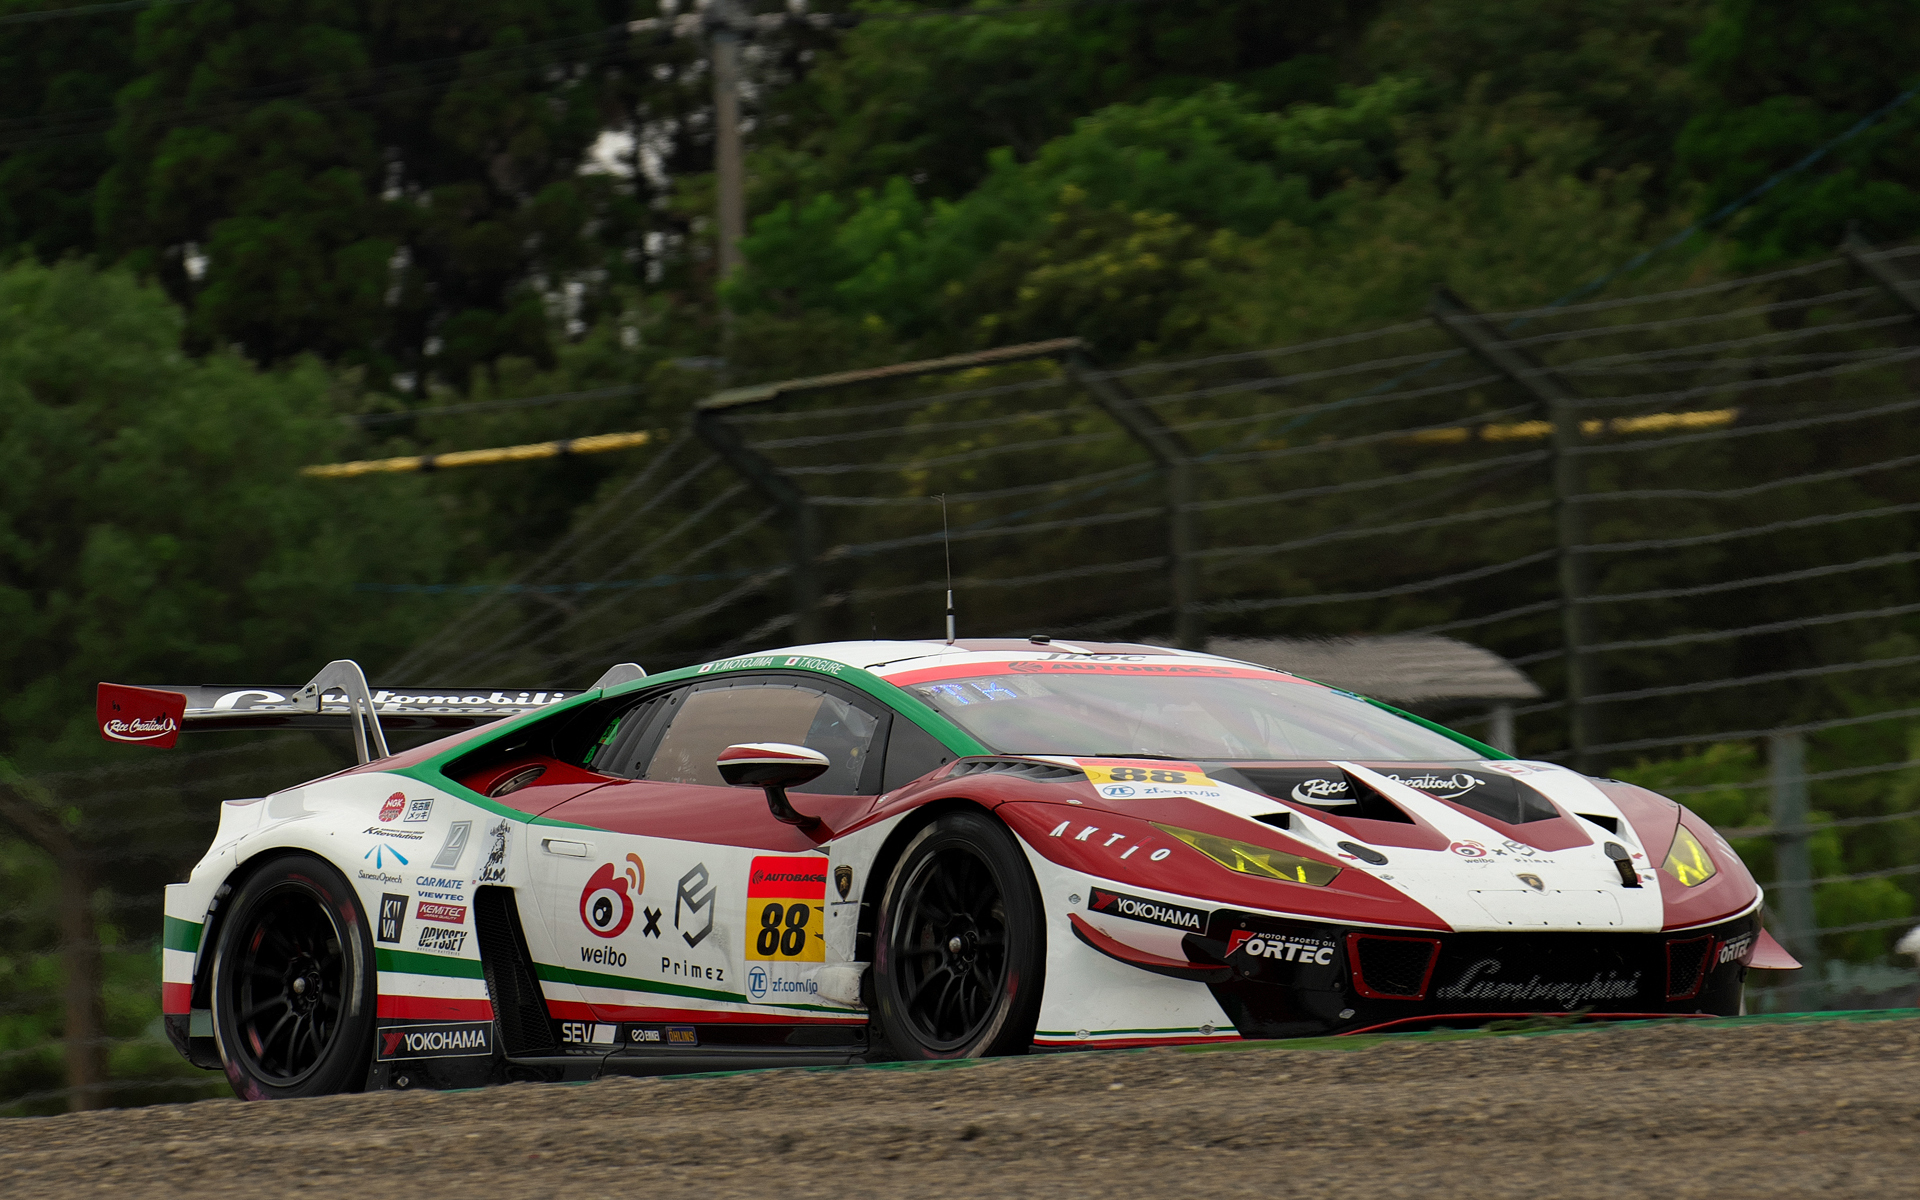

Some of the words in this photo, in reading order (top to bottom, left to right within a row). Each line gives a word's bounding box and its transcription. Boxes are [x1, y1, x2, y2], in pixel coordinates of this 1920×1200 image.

[798, 657, 845, 674] T.KOGURE
[1051, 664, 1232, 675] AUTOBACS
[1109, 767, 1187, 783] 88
[1303, 779, 1349, 798] Rice
[386, 799, 404, 808] NGK
[408, 811, 428, 820] メッキ
[1049, 821, 1171, 861] AKTIO
[416, 876, 464, 890] CARMATE
[418, 891, 464, 902] VIEWTEC
[1117, 897, 1200, 929] YOKOHAMA
[757, 902, 810, 957] 88
[418, 926, 468, 952] ODYSSEY
[1257, 932, 1286, 941] MOTOR
[1289, 936, 1319, 946] SPORTS
[580, 946, 627, 968] weibo
[773, 978, 818, 994] zf.com/jp
[405, 1029, 486, 1051] YOKOHAMA
[562, 1022, 592, 1043] SEV
